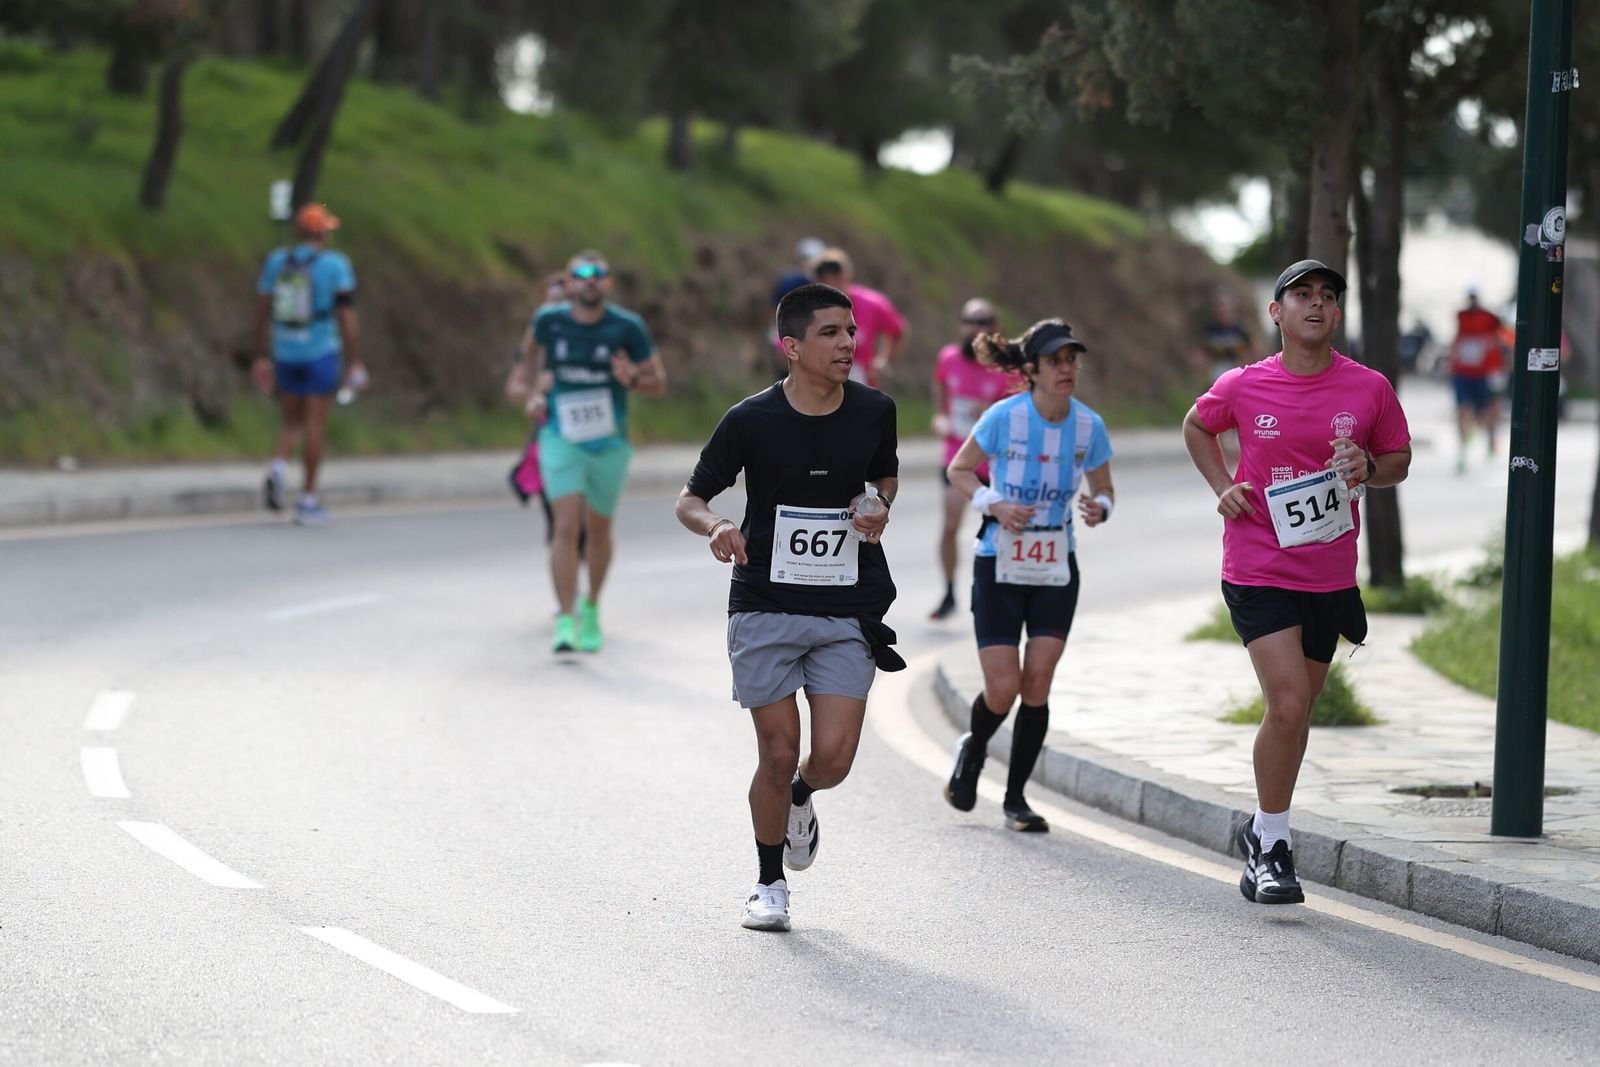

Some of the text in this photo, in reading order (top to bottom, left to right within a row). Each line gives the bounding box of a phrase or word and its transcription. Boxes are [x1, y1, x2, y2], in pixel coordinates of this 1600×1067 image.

[1285, 487, 1340, 528] 514
[789, 528, 848, 557] 667
[1011, 539, 1057, 563] 141
